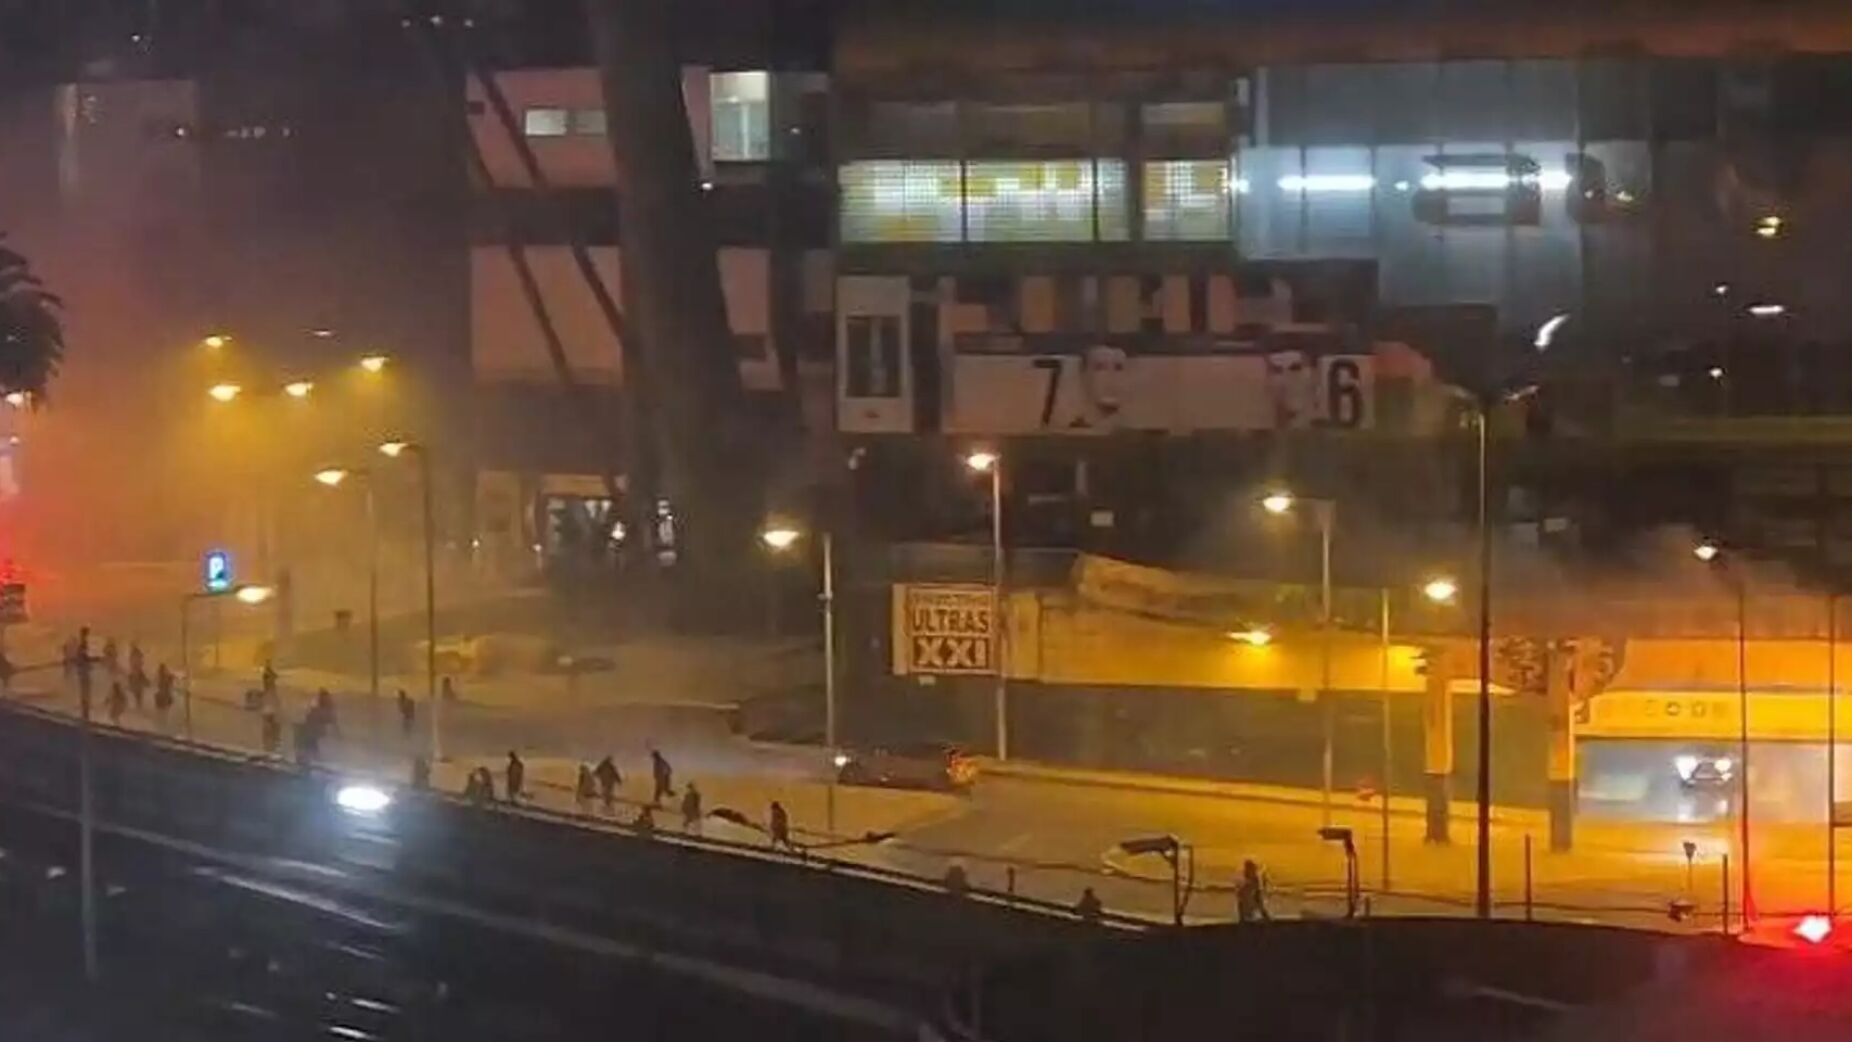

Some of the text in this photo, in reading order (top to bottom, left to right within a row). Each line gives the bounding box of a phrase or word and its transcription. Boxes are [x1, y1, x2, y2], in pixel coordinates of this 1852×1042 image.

[1032, 359, 1063, 428] 7
[1328, 359, 1361, 428] 6
[209, 557, 224, 579] P
[912, 609, 989, 633] ULTRAS
[916, 636, 987, 667] XXI
